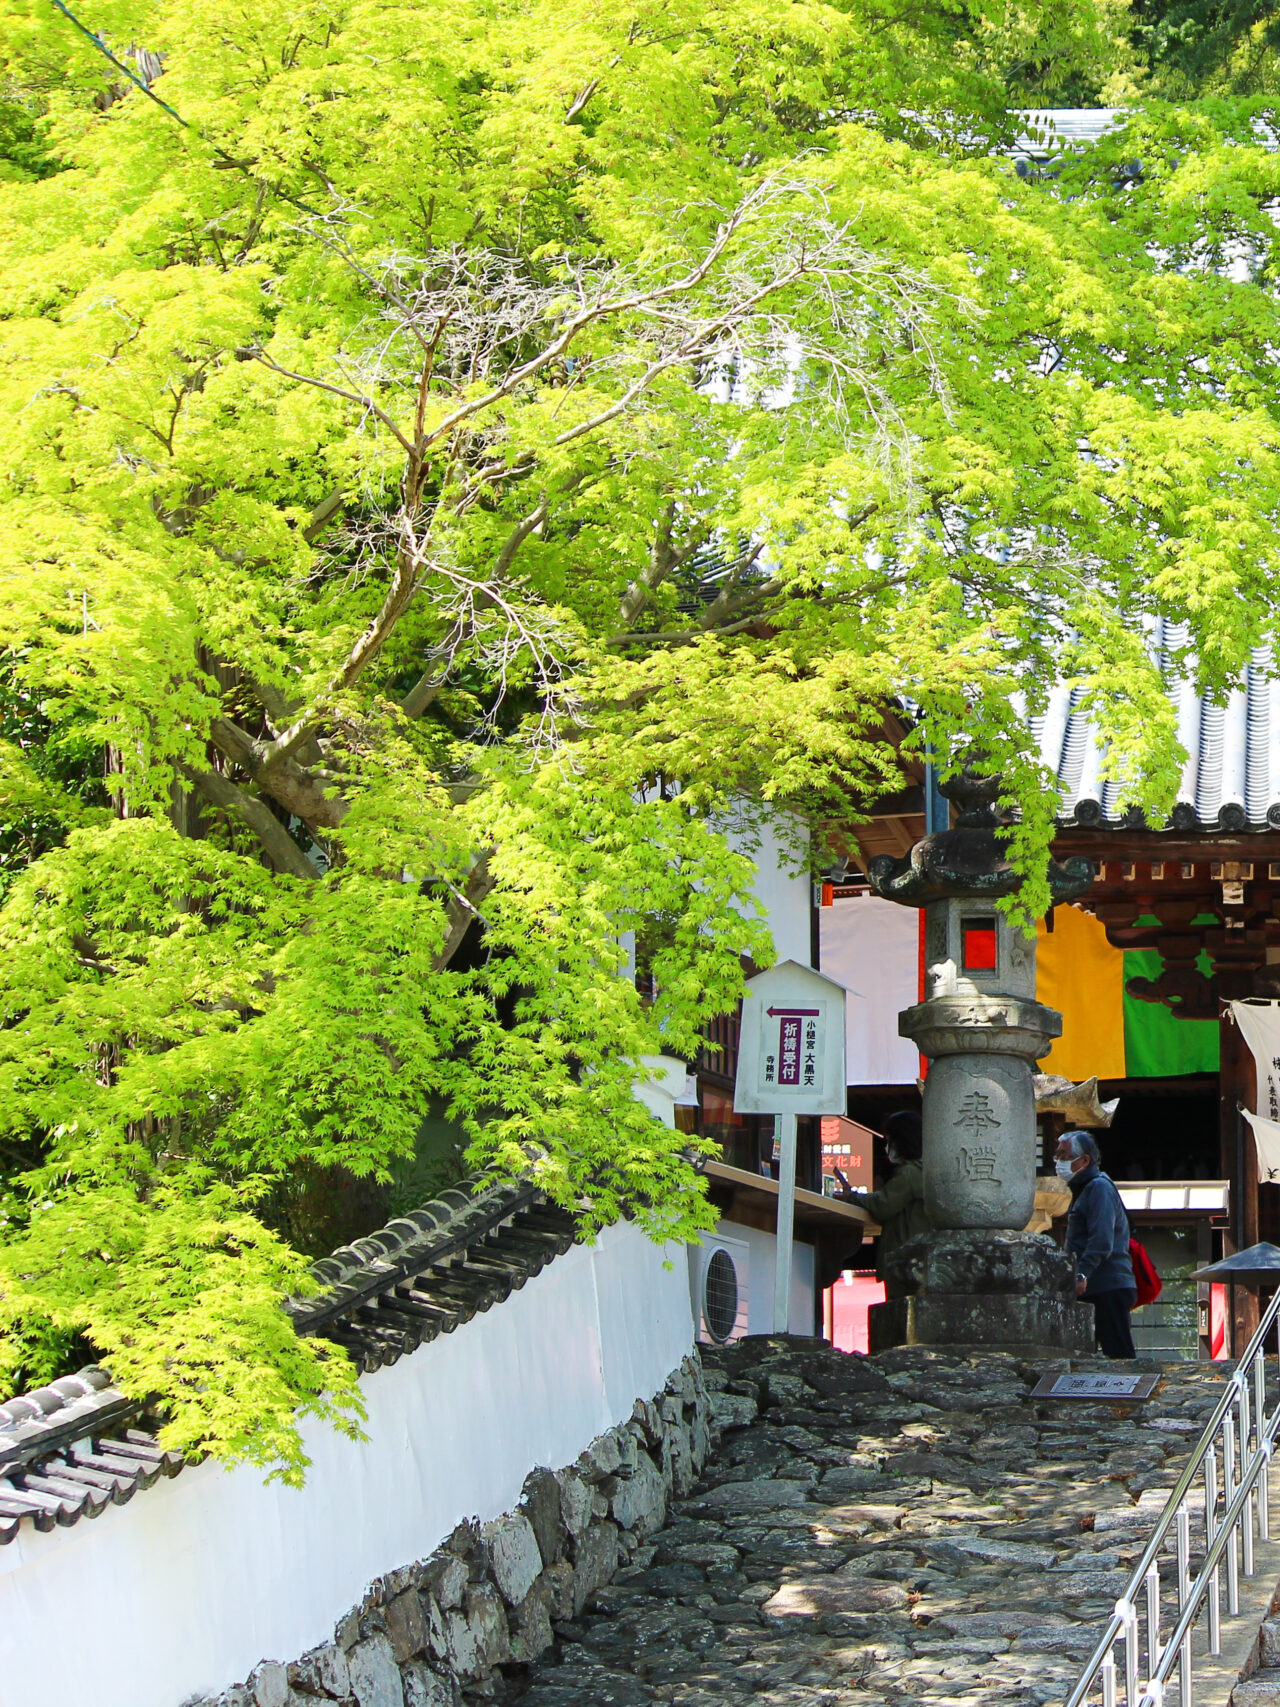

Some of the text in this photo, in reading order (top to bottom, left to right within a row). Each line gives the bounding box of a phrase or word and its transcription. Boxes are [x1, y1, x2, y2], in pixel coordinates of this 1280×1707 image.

[765, 1055, 775, 1082] 寺務所
[782, 1022, 798, 1080] 祈祷受付
[804, 1020, 817, 1086] 小槌宮 大黒天
